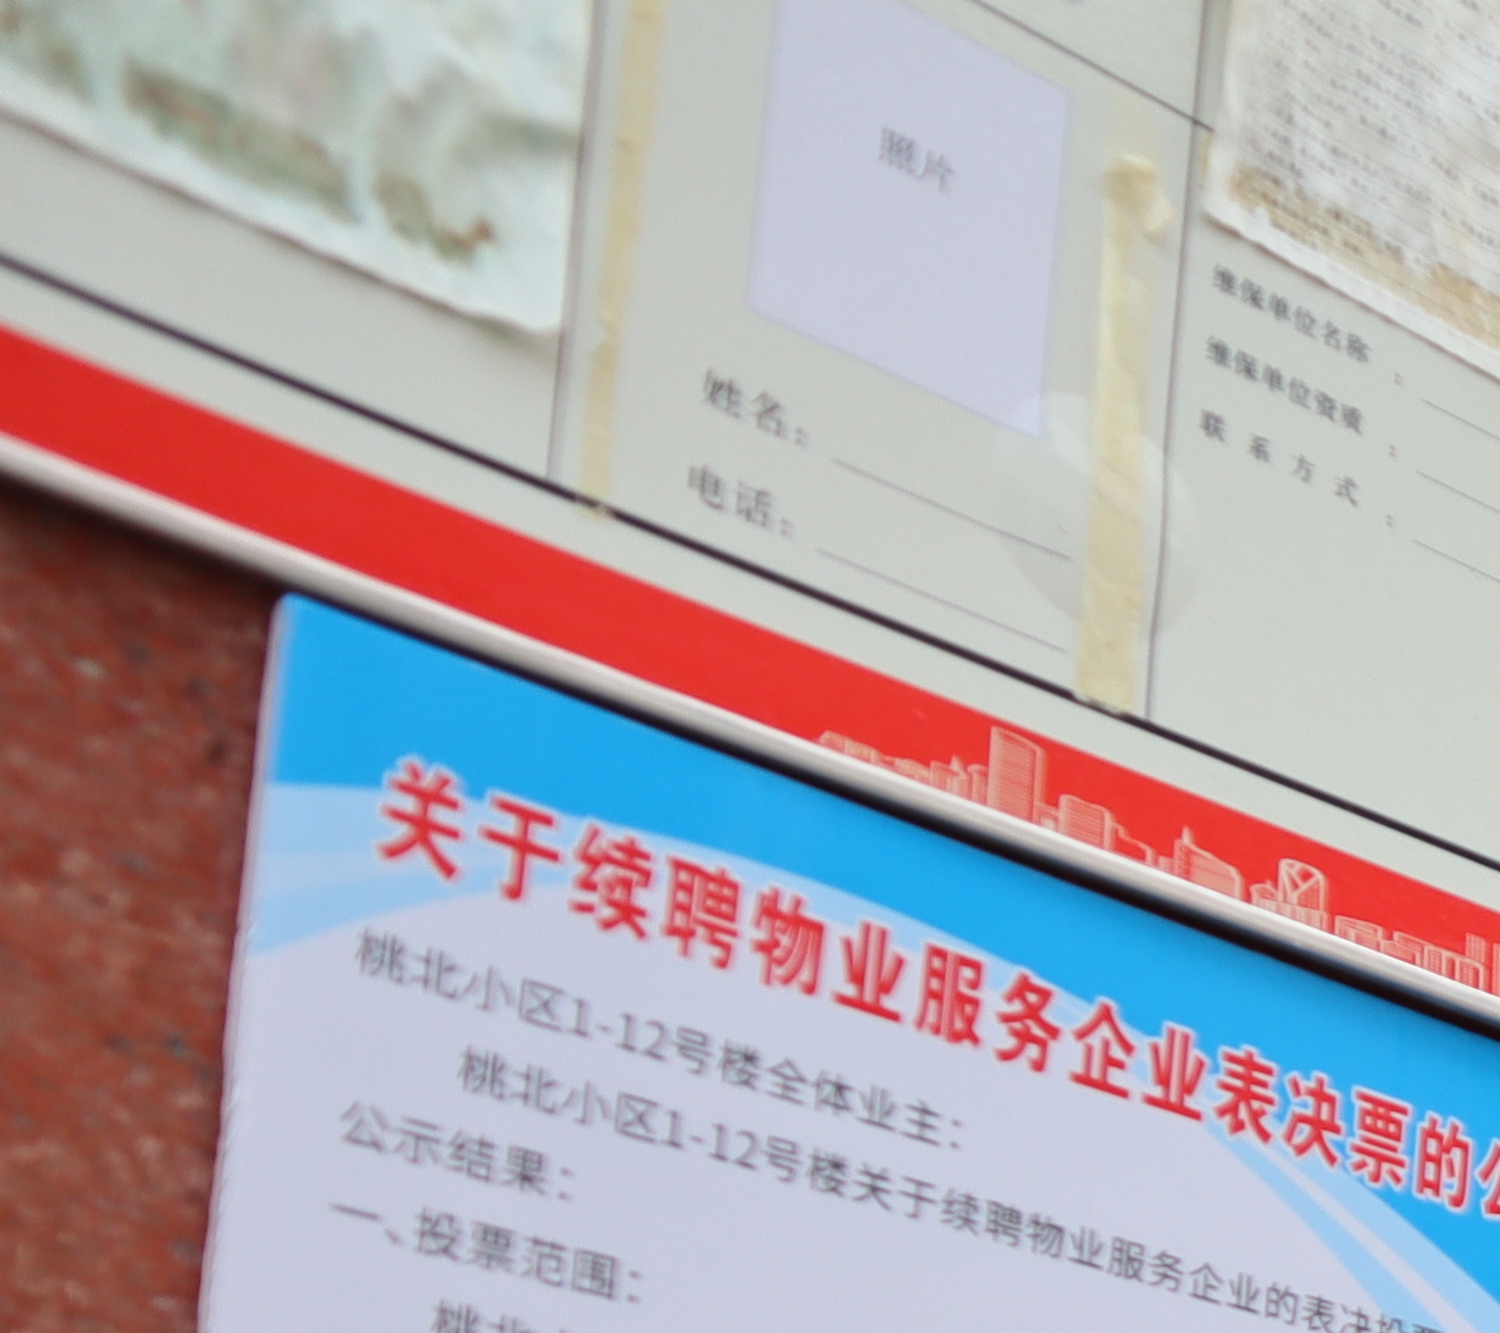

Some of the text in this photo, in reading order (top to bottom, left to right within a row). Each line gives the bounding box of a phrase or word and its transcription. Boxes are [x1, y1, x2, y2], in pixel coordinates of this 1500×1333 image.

[878, 124, 958, 197] 照片
[703, 368, 811, 449] 姓名：
[688, 462, 796, 539] 电话：
[355, 928, 966, 1150] 桃北小区1-12号楼全体业主：
[337, 1100, 575, 1202] 公示结果：
[328, 1201, 643, 1302] 一、投票范围：
